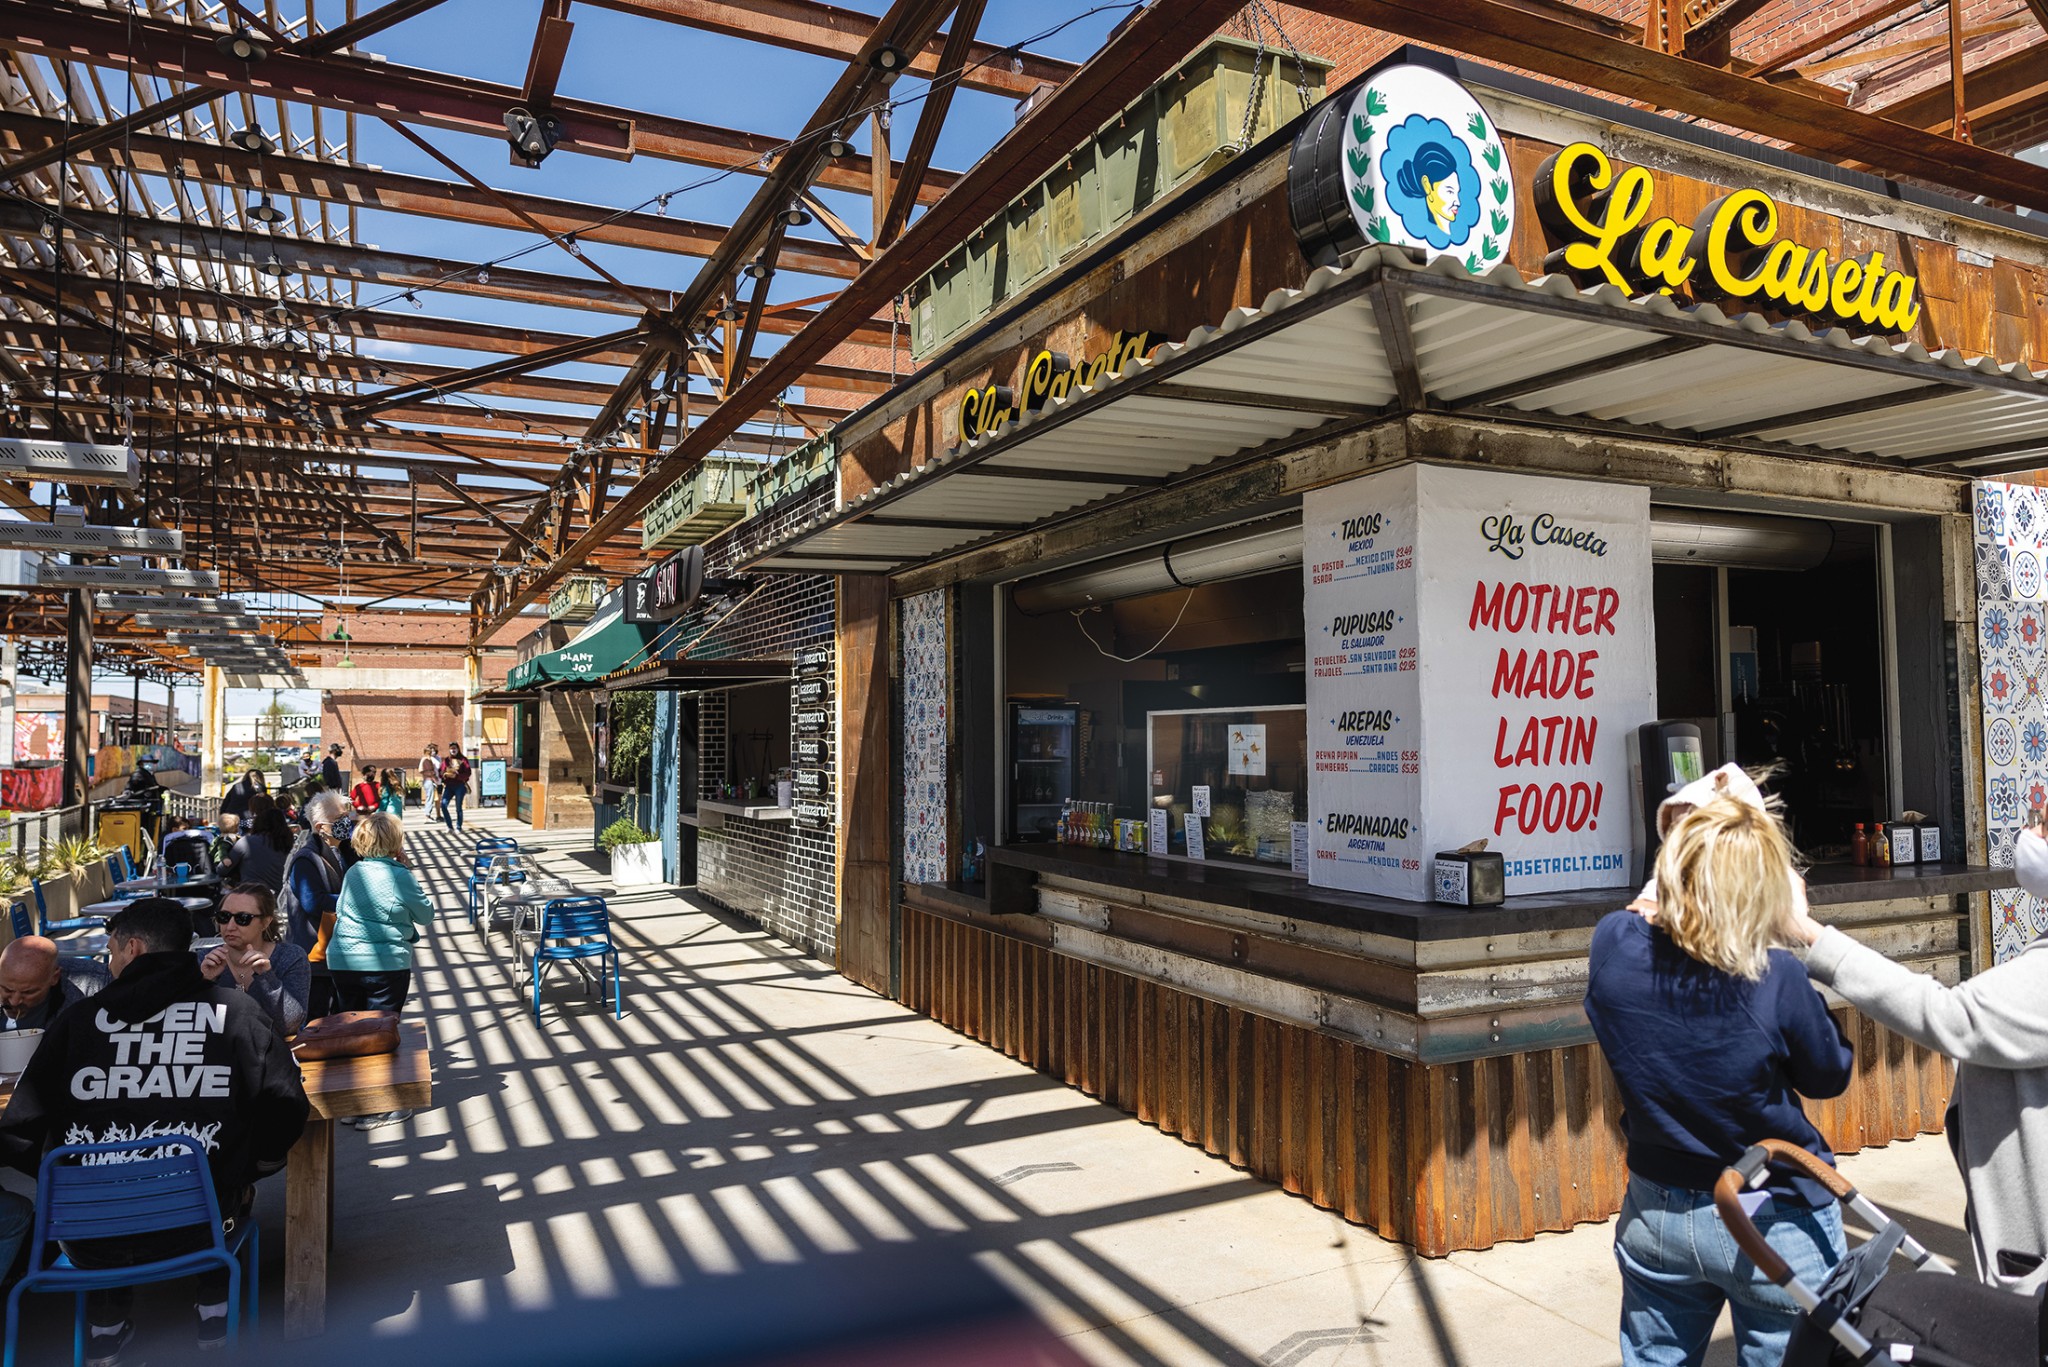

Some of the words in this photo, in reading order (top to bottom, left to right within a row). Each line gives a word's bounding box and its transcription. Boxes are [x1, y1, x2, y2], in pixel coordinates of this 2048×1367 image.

[1553, 141, 1697, 297] La
[1708, 188, 1921, 333] Caseta
[1342, 512, 1382, 540] TACOS
[1480, 514, 1526, 560] La
[1531, 513, 1608, 557] Caseta
[1348, 538, 1374, 552] MEXICO
[1313, 564, 1320, 574] AL
[1321, 560, 1344, 572] PASTOR
[1356, 553, 1379, 565] MEXICO
[1380, 550, 1395, 561] CITY
[1395, 545, 1413, 559] $3.49
[1313, 574, 1333, 585] ASADA
[1367, 562, 1395, 575] TIJUANA
[1395, 558, 1413, 571] $3.95
[656, 562, 678, 608] SARU
[1468, 580, 1620, 636] MOTHER
[1332, 609, 1395, 637] PUPUSAS
[1341, 639, 1349, 650] EL
[1350, 635, 1385, 649] SALVADOR
[560, 652, 593, 662] PLANT
[572, 663, 593, 673] JOY
[1314, 655, 1347, 666] REVUELTAS
[1350, 653, 1363, 663] SAN
[1364, 650, 1396, 662] SALVADOR
[1398, 647, 1416, 660] $2.95
[1314, 667, 1342, 678] FRIJOLES
[1362, 664, 1382, 674] SANTA
[1383, 662, 1398, 672] ANA
[1398, 660, 1416, 672] $2.95
[1491, 647, 1600, 700] MADE
[1338, 709, 1393, 732] AREPAS
[1345, 735, 1385, 746] VENEZUELA
[1494, 715, 1598, 769] LATIN
[1315, 762, 1349, 772] RUMBERAS
[1369, 763, 1399, 773] CARACAS
[1401, 762, 1419, 774] $5.95
[1336, 751, 1358, 760] PIPIAN
[1376, 751, 1399, 761] ANDES
[1401, 750, 1419, 761] $5.95
[1493, 781, 1603, 837] FOOD!
[1326, 813, 1409, 839] EMPANADAS
[1347, 838, 1386, 852] ARGENTINA
[1316, 849, 1337, 861] CARNE
[1367, 856, 1400, 868] MENDOZA
[1401, 858, 1420, 871] $3.95
[1503, 854, 1624, 877] CASETACLT.COM
[109, 1032, 207, 1066] THE
[70, 1065, 232, 1101] GRAVE
